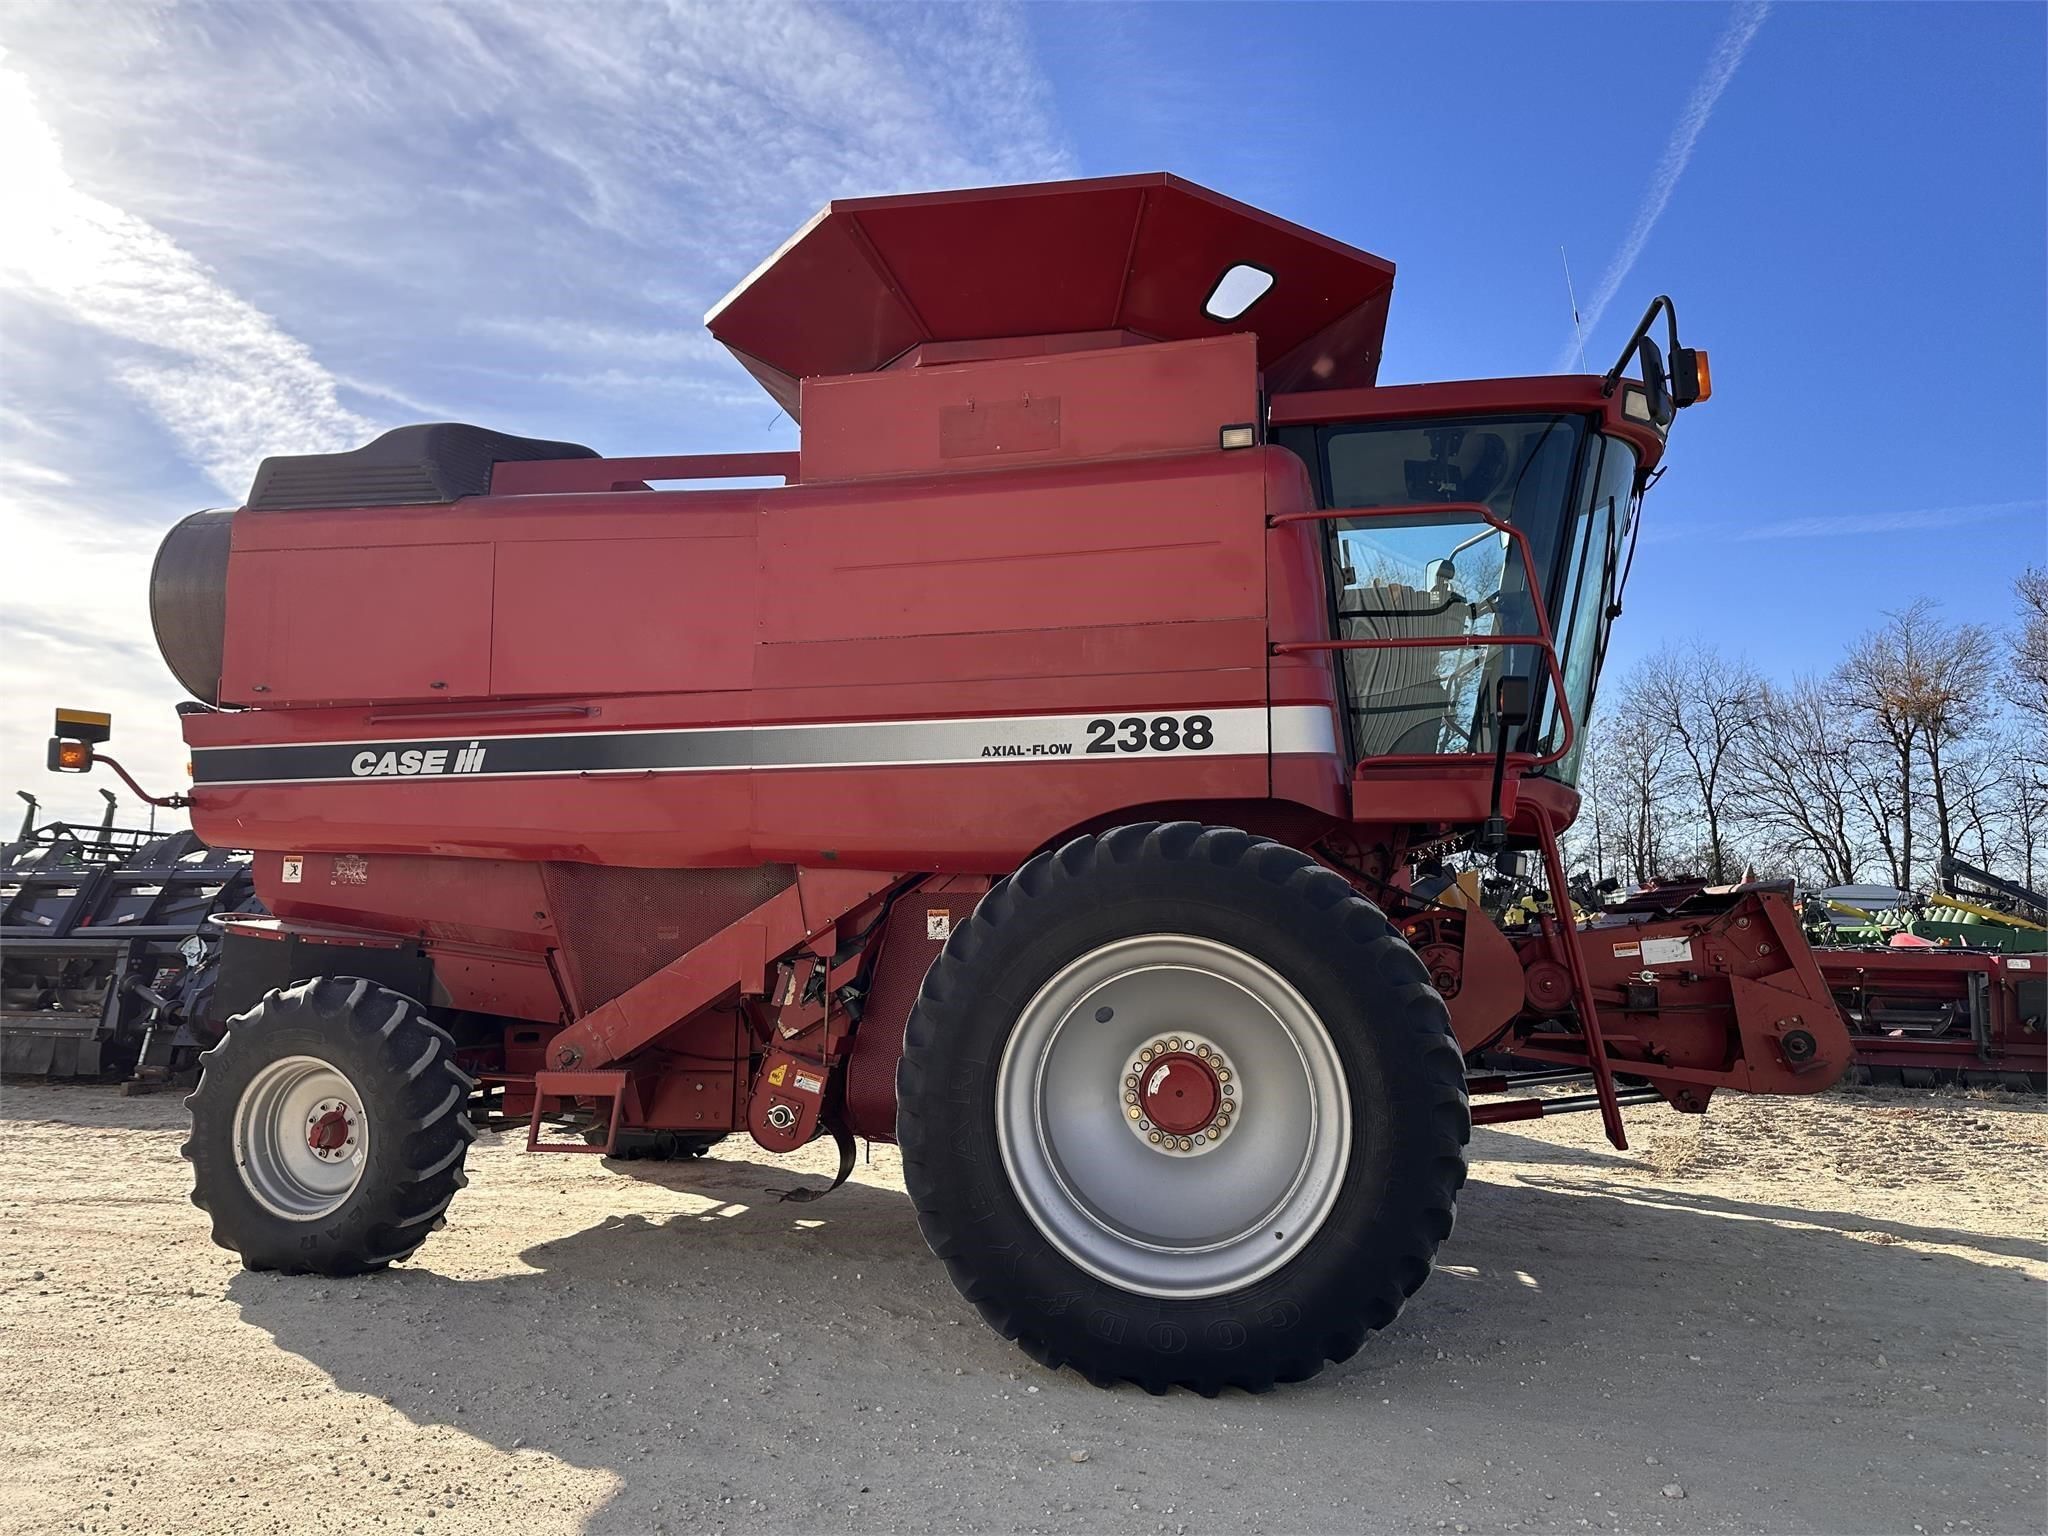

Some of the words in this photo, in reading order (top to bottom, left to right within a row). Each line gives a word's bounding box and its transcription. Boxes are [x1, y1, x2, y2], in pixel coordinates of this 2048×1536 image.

[981, 743, 1073, 757] AXIAL-FLOW
[1085, 714, 1215, 754] 2388
[351, 749, 449, 776] CASE
